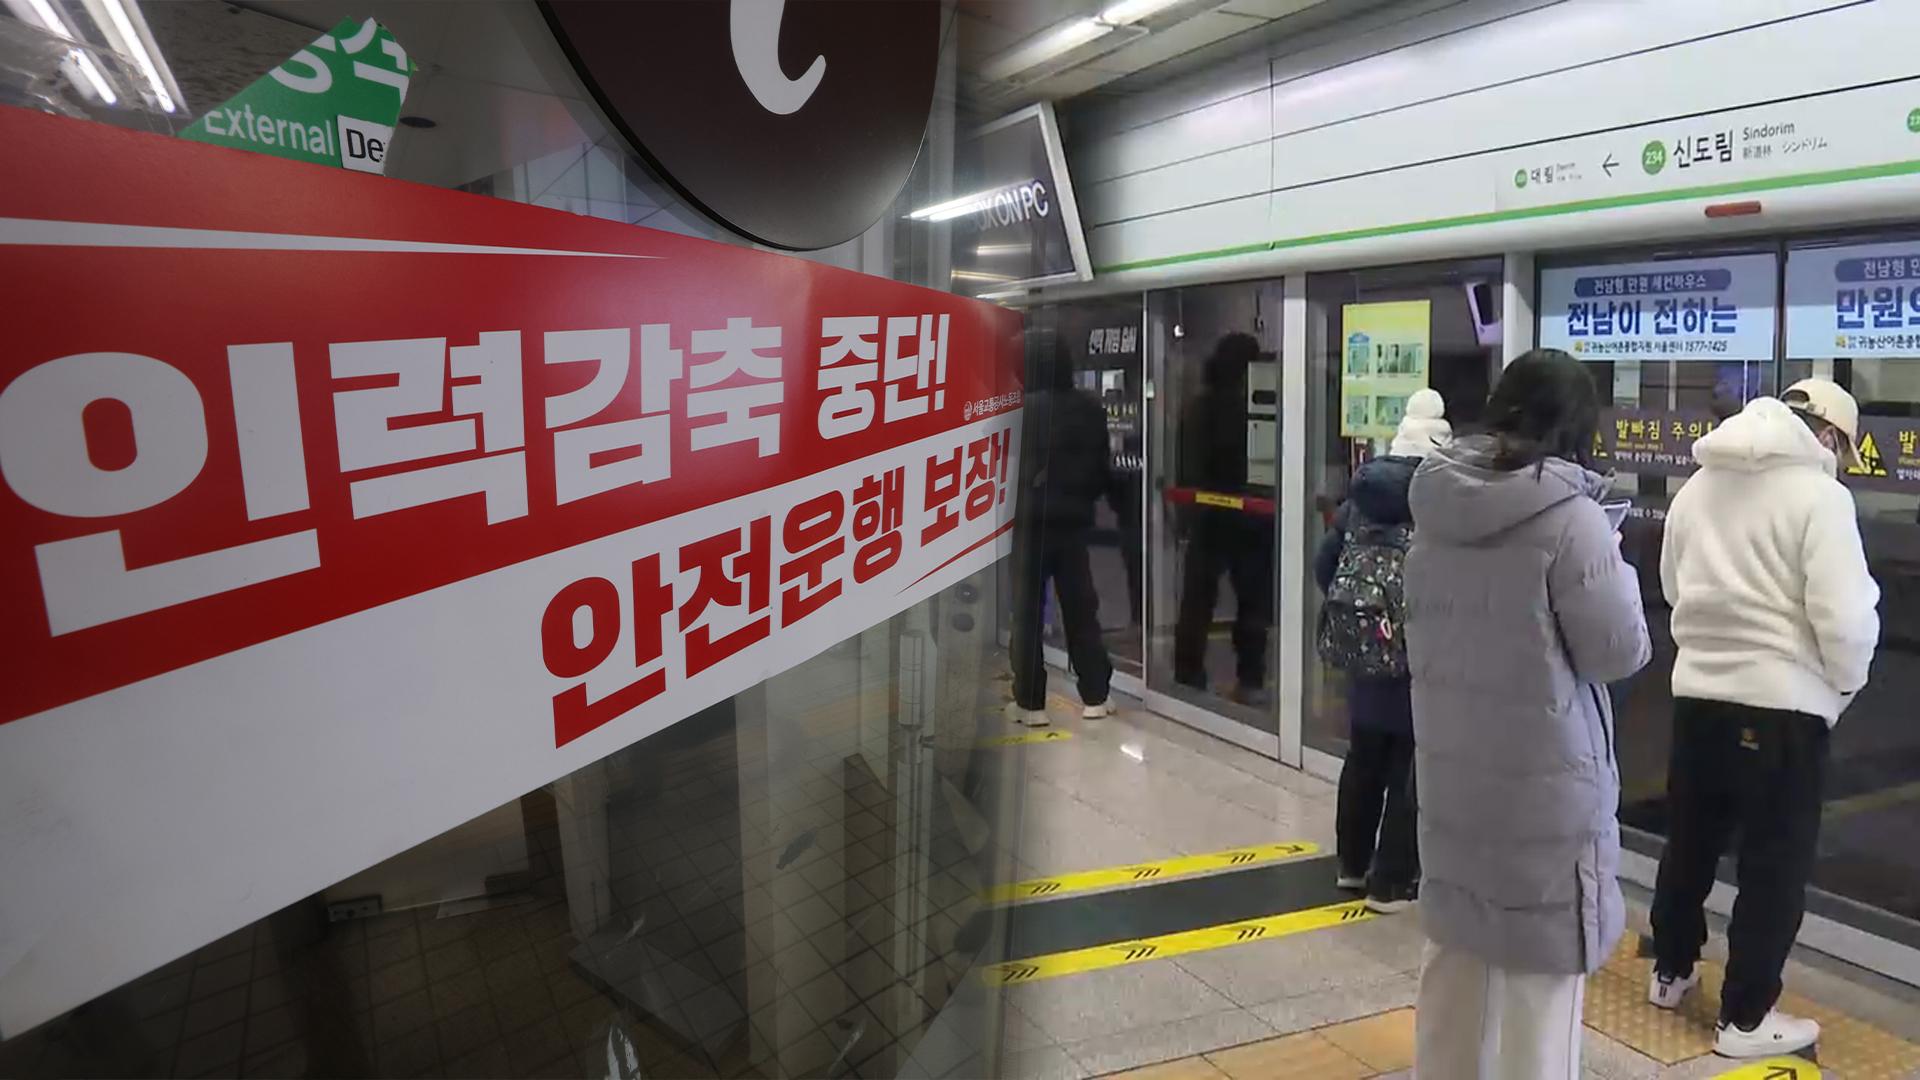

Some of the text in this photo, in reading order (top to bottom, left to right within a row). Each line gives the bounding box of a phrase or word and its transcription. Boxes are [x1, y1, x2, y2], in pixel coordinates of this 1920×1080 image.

[204, 104, 335, 156] External
[1645, 129, 1735, 169] 234 신도림
[1743, 122, 1795, 141] Sindorim
[996, 189, 1022, 226] ON
[1020, 181, 1048, 220] PC
[1864, 258, 1905, 279] 전남형
[1567, 297, 1738, 336] 전남이 전하는
[1616, 419, 1661, 440] 발빠짐
[0, 314, 950, 637] 인력감축 중단!
[541, 428, 1011, 749] 안전운행 보장!
